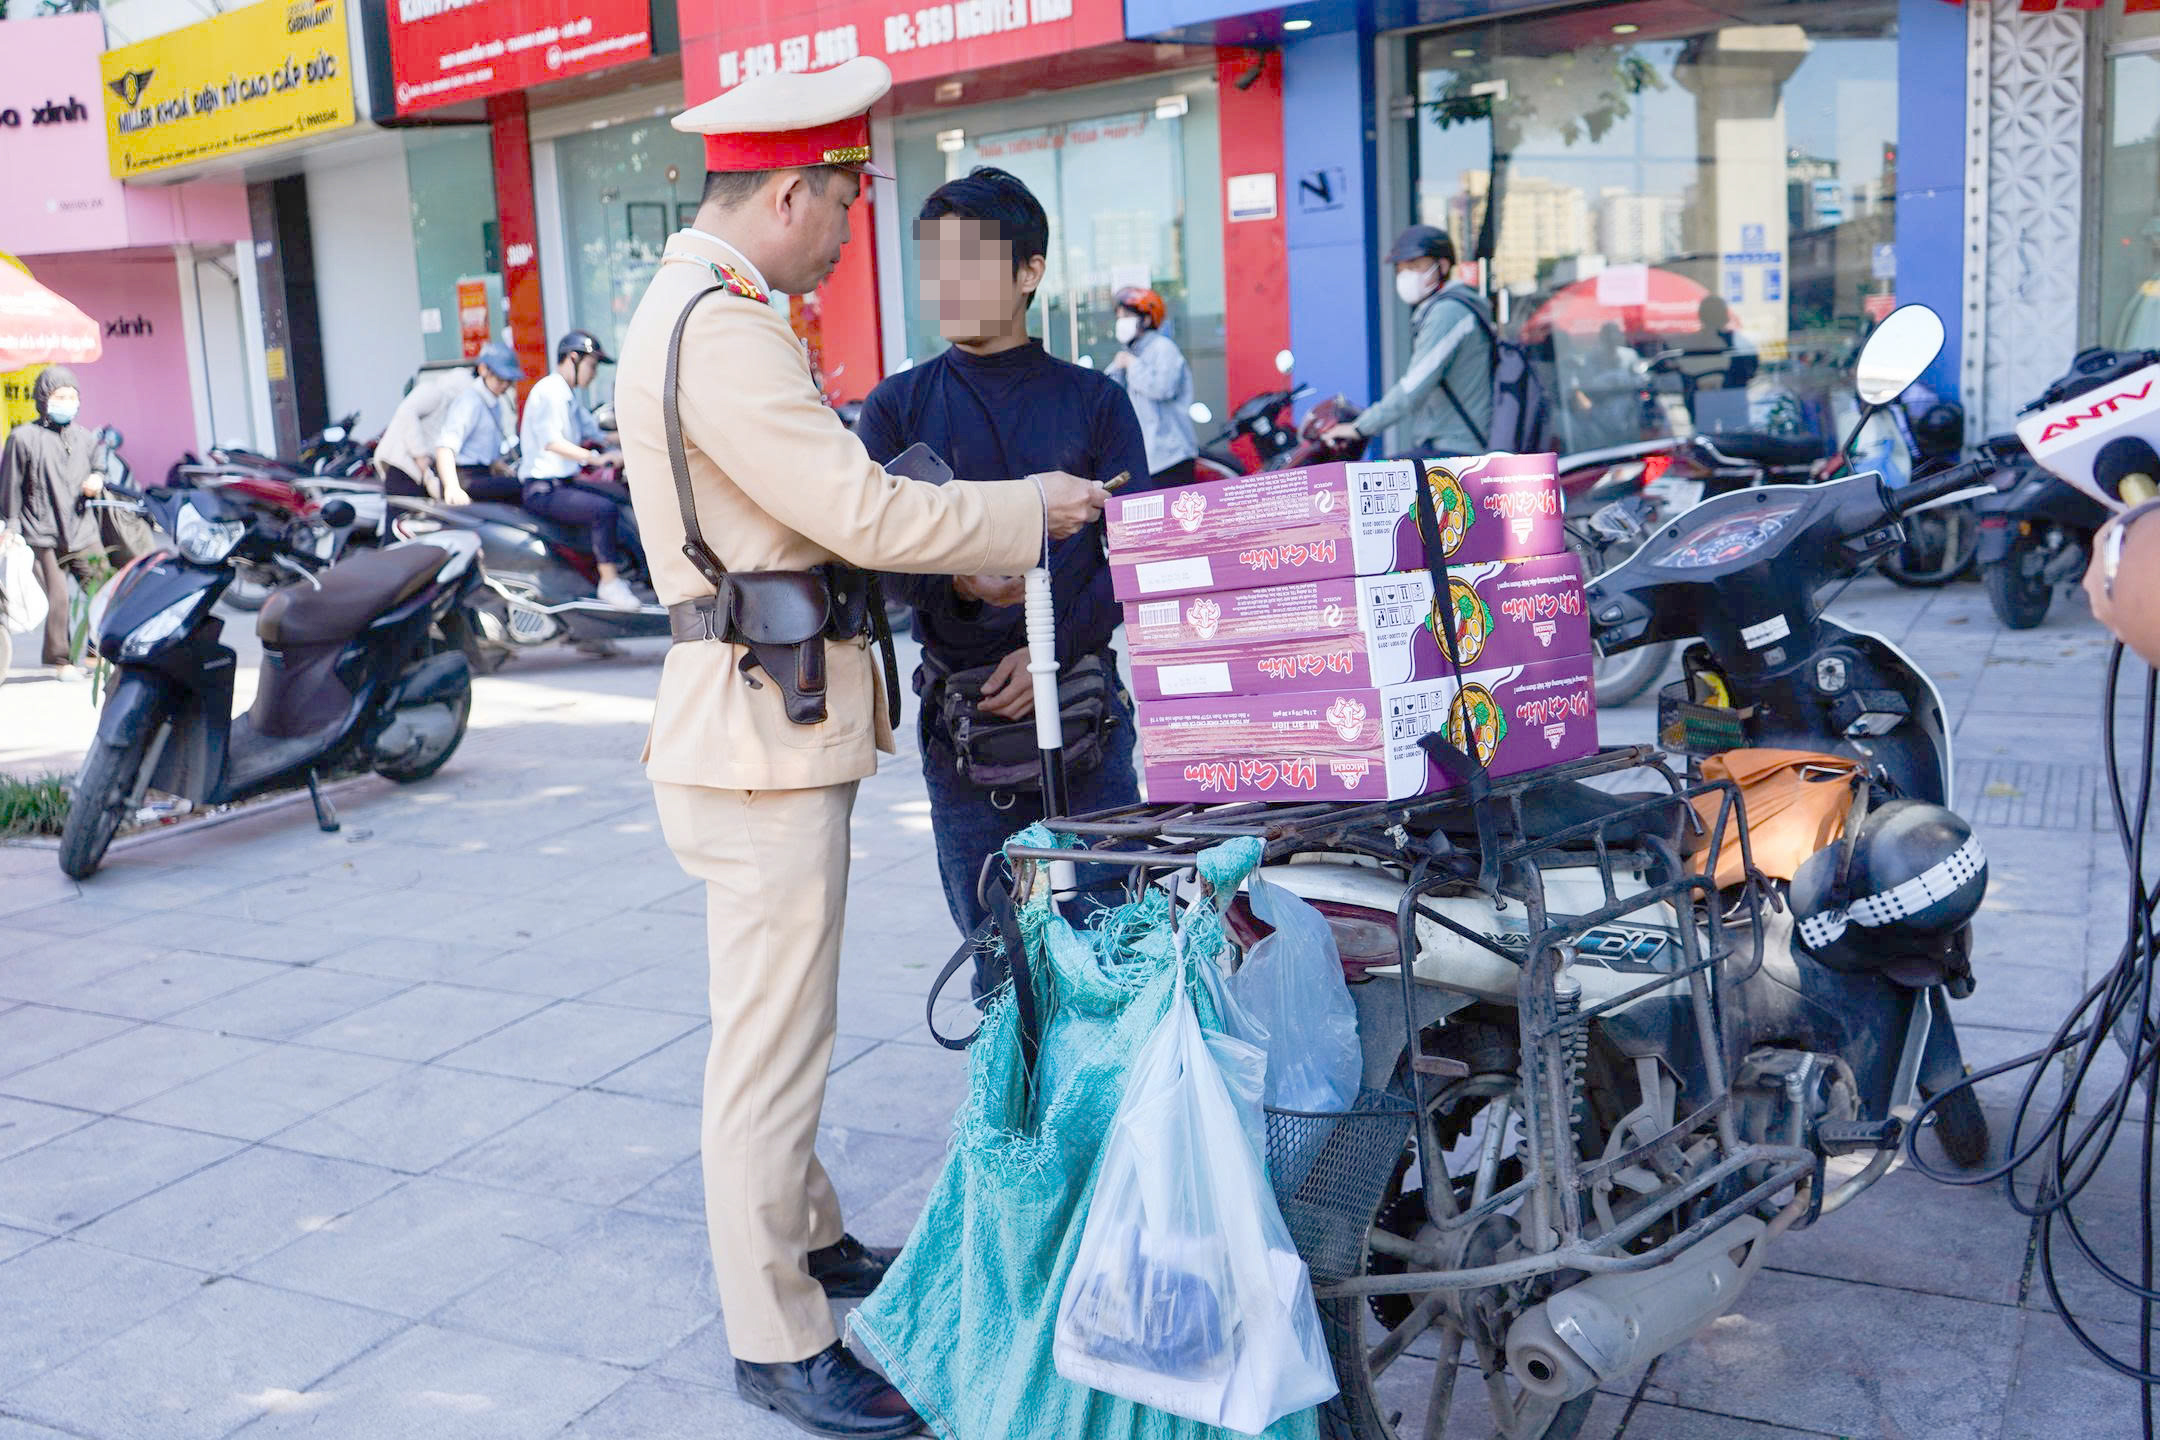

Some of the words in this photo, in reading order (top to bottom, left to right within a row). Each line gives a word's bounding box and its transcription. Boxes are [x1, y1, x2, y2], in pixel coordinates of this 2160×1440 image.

[118, 107, 153, 134] MILLER
[157, 88, 190, 123] KHOÁ
[193, 82, 219, 117] ĐIỆN
[222, 73, 237, 105] TỬ
[240, 74, 270, 101] CAO
[273, 56, 302, 91] CẤP
[306, 48, 336, 84] ĐỨC
[106, 314, 153, 338] xinh
[2039, 380, 2153, 443] ANTV
[1239, 548, 1278, 571] Nấm
[1280, 545, 1308, 567] Gà
[1310, 540, 1336, 564] Mì
[1502, 597, 1535, 623] Nấm
[1535, 593, 1559, 619] Gà
[1559, 590, 1580, 615] Mì
[1258, 656, 1296, 679] Nấm
[1296, 654, 1325, 676] Gà
[1327, 650, 1353, 674] Mì
[1516, 699, 1547, 726] Nấm
[1548, 696, 1570, 720] Gà
[1570, 691, 1588, 717] Mì
[1272, 721, 1289, 735] liền
[1184, 762, 1236, 793] Nấm
[1239, 759, 1278, 791] Gà
[1280, 757, 1316, 790] Mì
